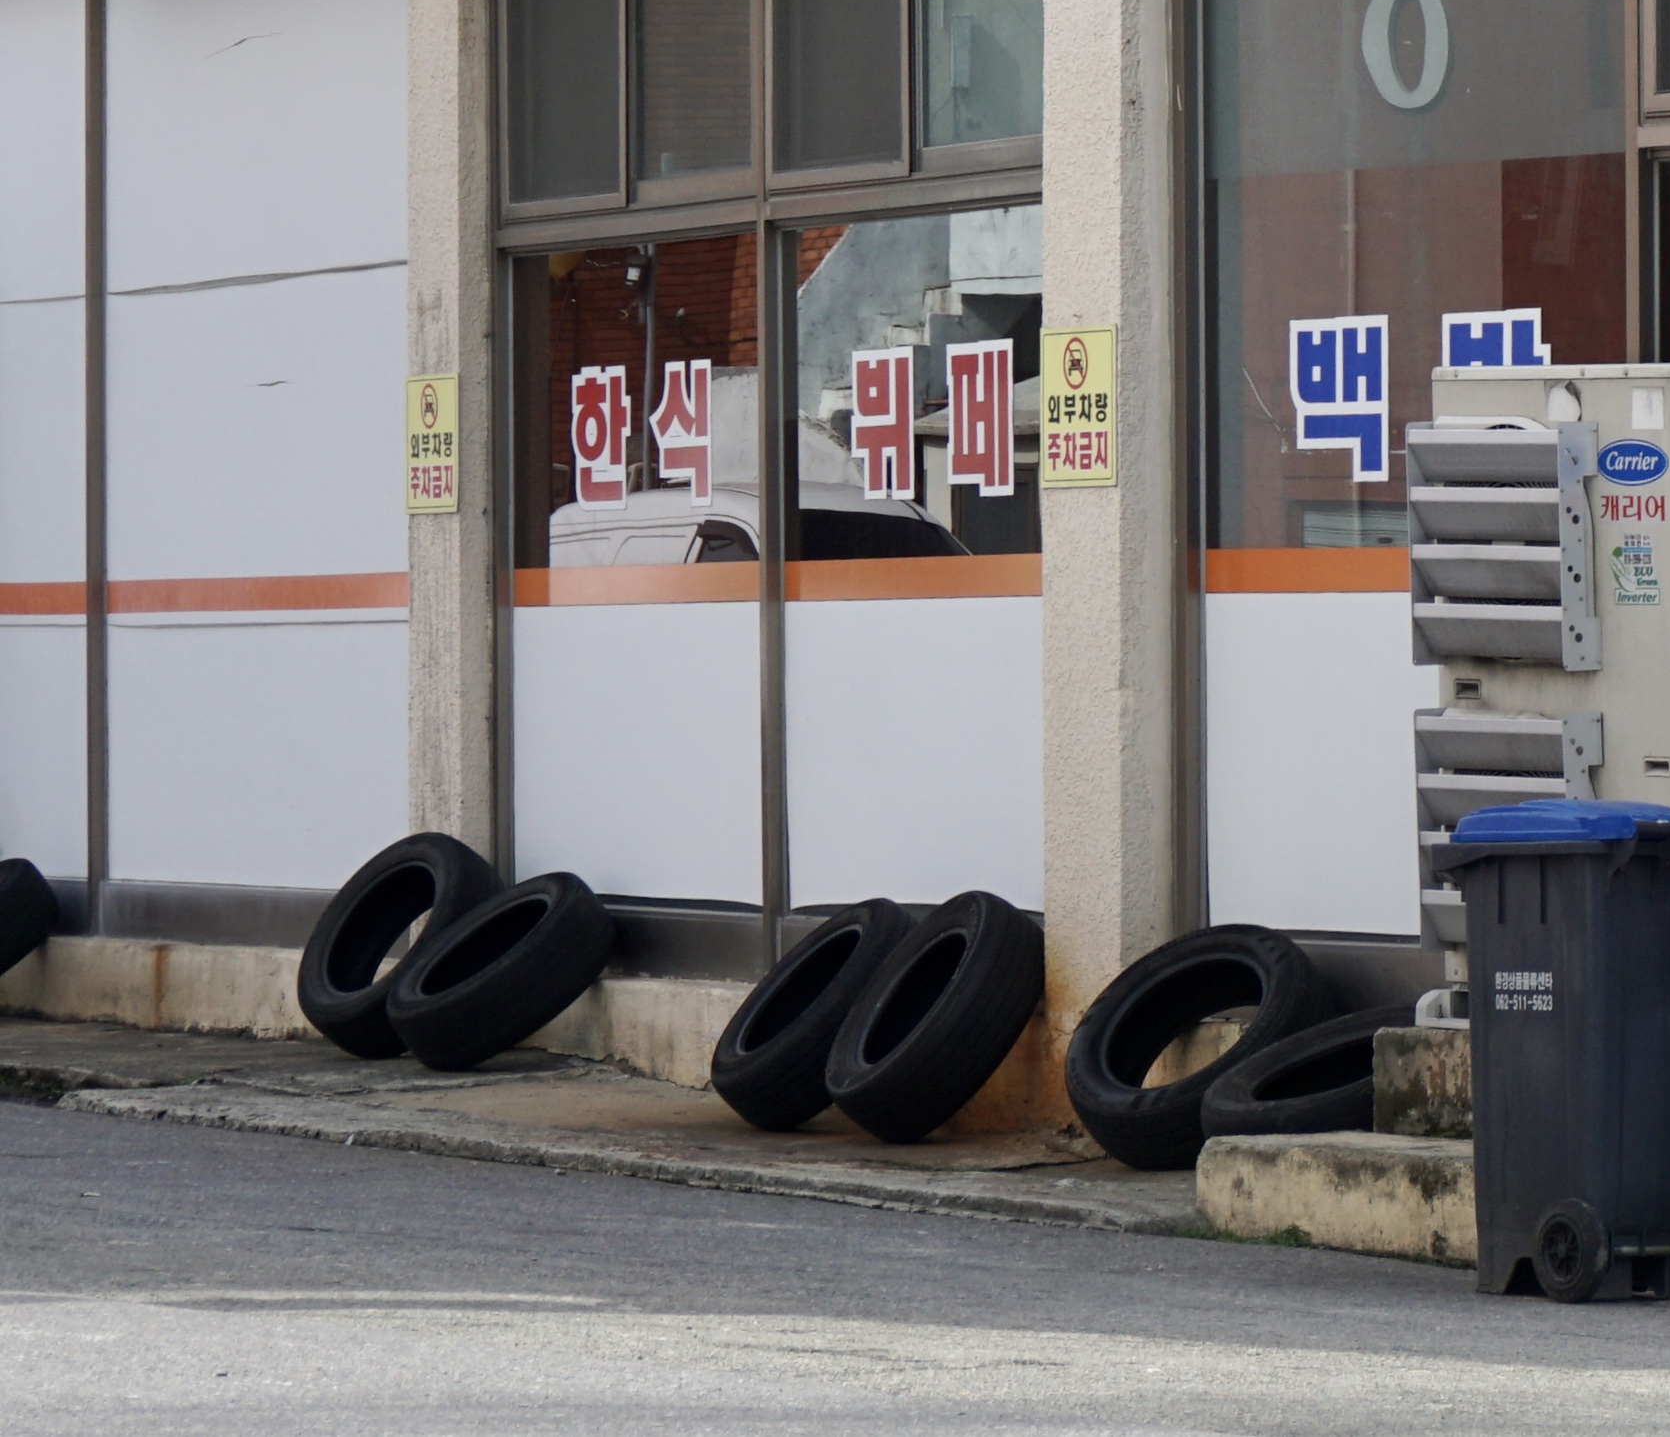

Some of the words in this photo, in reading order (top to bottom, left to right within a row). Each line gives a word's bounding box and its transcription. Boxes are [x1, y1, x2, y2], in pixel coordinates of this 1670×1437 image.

[1048, 393, 1108, 427] 외부차량
[575, 363, 711, 505] 한식
[854, 347, 1012, 493] 뷔페
[409, 432, 453, 459] 외부차량
[1047, 431, 1109, 471] 주차금지
[1606, 450, 1659, 471] Carrier
[409, 464, 454, 500] 주차금지
[1600, 495, 1666, 522] 캐리어
[1616, 591, 1659, 604] Inverter
